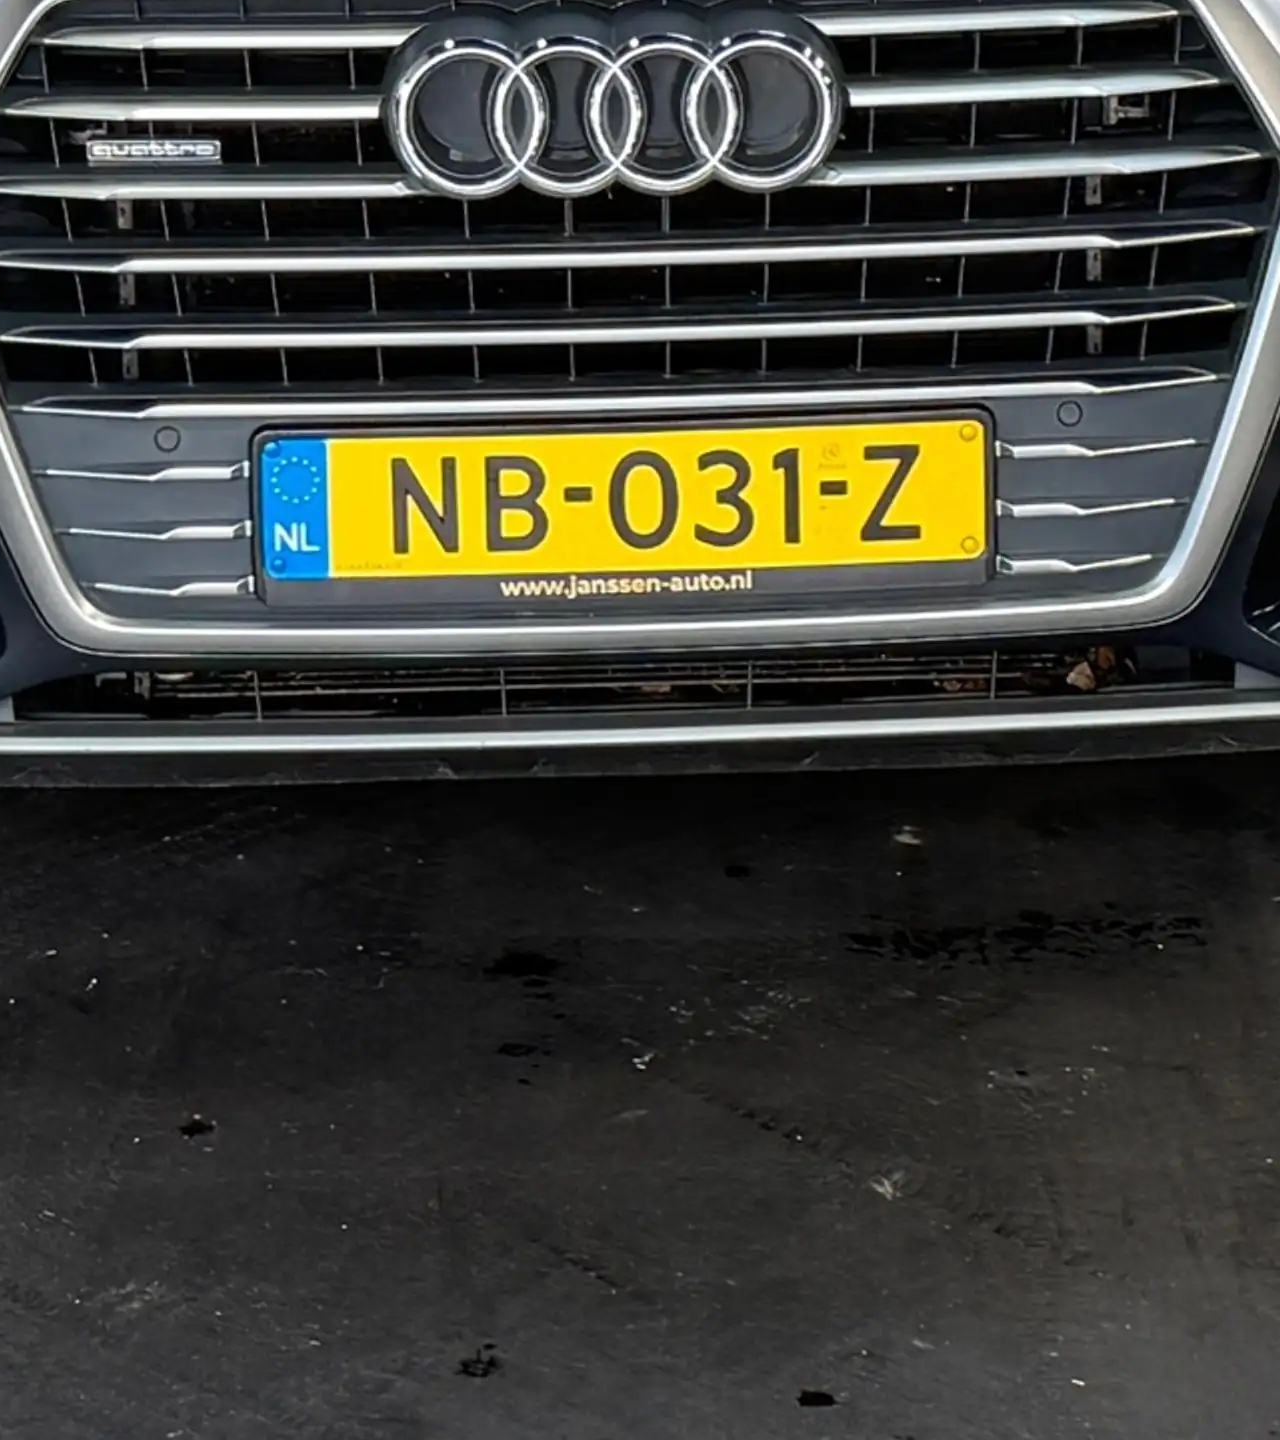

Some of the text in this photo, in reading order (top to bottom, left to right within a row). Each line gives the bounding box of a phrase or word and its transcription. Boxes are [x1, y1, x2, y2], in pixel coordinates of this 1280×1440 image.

[91, 140, 215, 159] quattro
[273, 443, 923, 555] NL NB-031-Z
[499, 569, 753, 600] www.janssen-auto.nl
